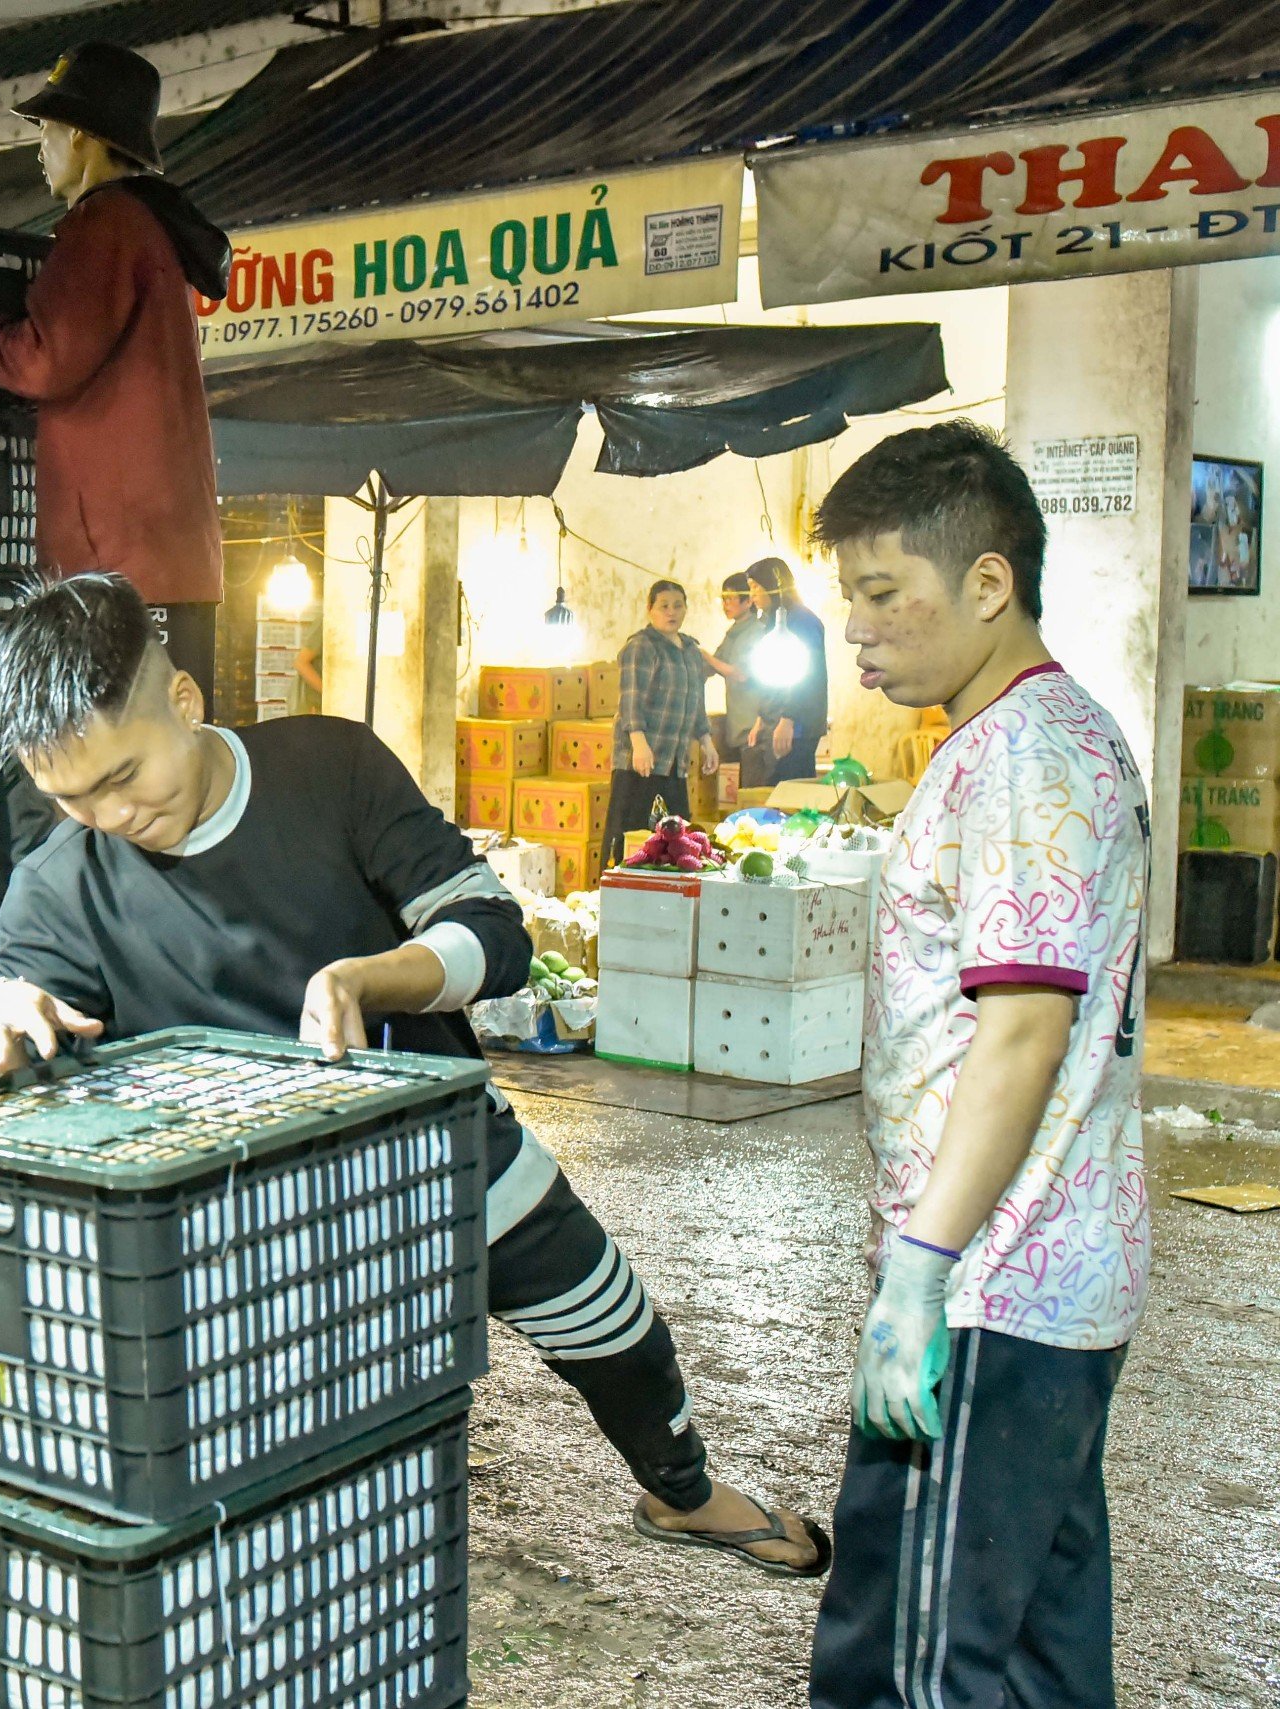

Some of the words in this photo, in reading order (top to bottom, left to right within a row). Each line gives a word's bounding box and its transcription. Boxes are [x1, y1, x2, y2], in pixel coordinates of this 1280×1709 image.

[920, 113, 1280, 224] THA
[195, 246, 334, 317] ỠNG
[353, 229, 469, 299] HOA
[490, 183, 619, 287] QUẢ
[878, 224, 1032, 274] KIỐT
[1055, 220, 1123, 256] 21
[1189, 203, 1280, 240] ĐT
[400, 281, 580, 325] 0979.561402
[1046, 444, 1083, 459] INTERNET
[1108, 441, 1135, 456] QUANG
[1039, 495, 1132, 514] 989.039.782
[1208, 786, 1261, 808] TRANG
